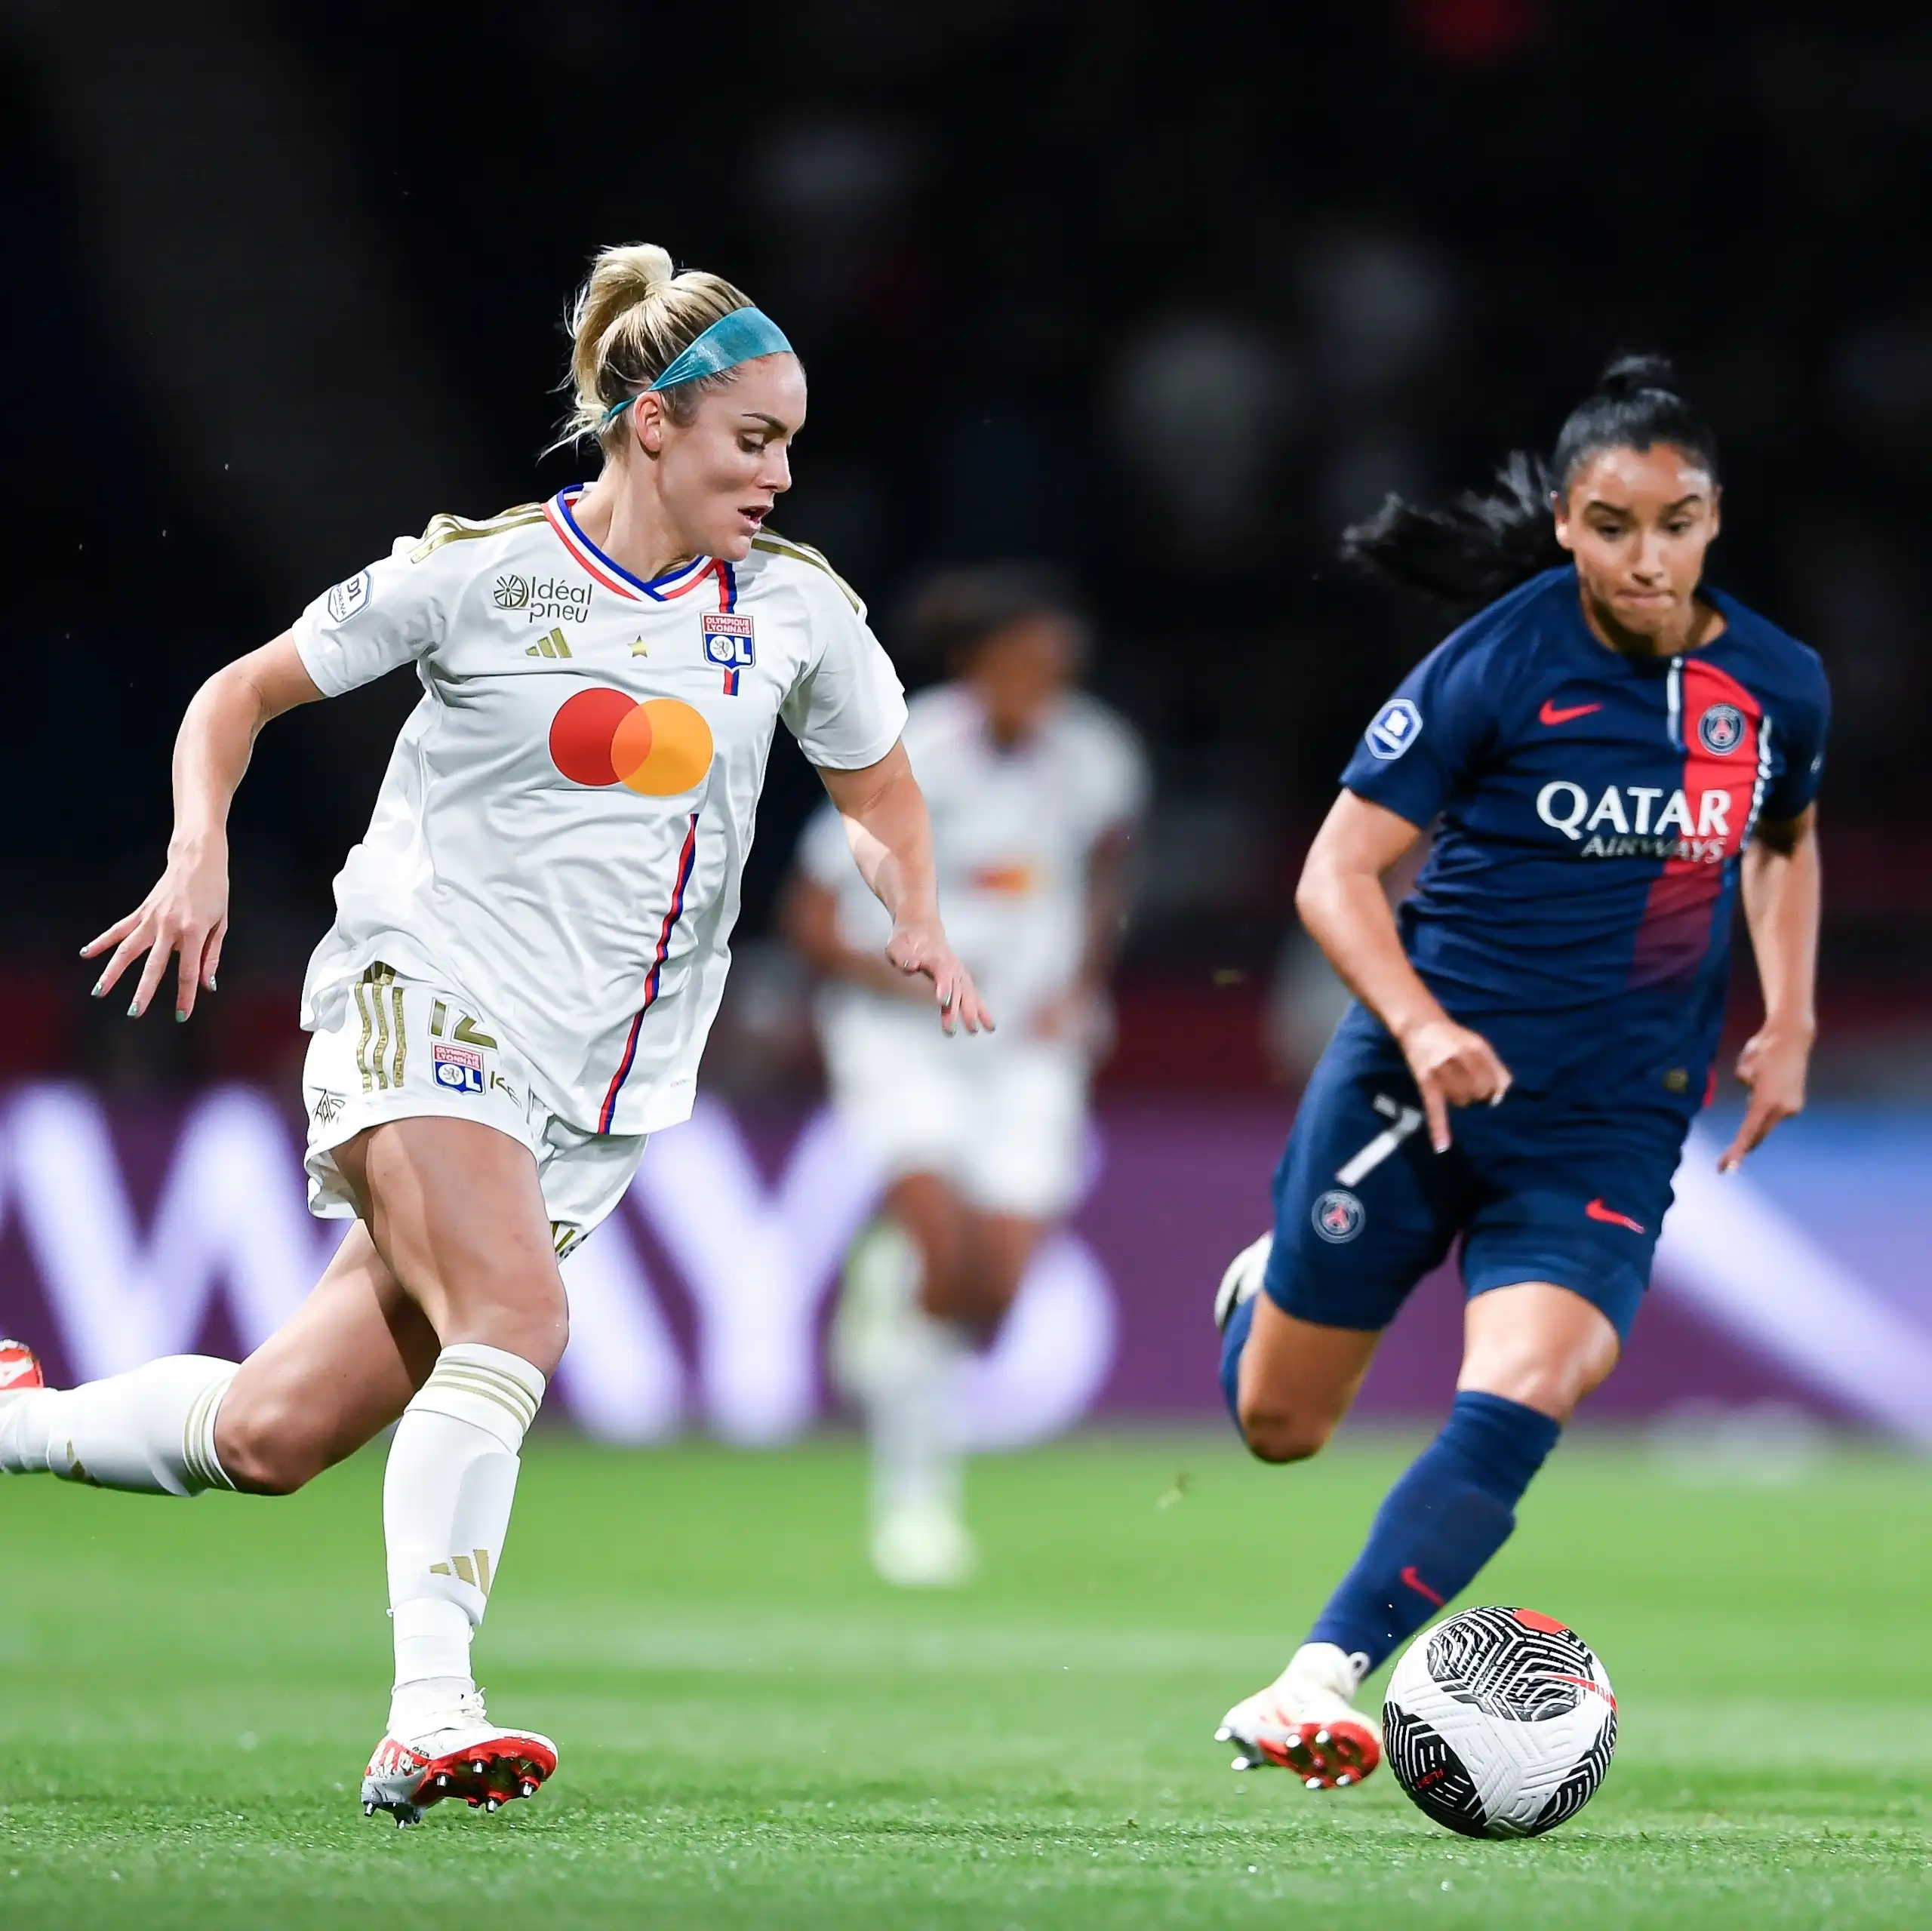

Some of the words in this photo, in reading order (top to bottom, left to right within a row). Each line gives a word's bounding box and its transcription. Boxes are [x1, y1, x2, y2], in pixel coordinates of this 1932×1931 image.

[531, 577, 592, 605] Idéal
[529, 602, 589, 623] pneu
[706, 617, 749, 627] OLYMPIQUE
[706, 624, 750, 635] LYONNAIS
[1537, 780, 1731, 841] QATAR
[1334, 1093, 1423, 1187] 7
